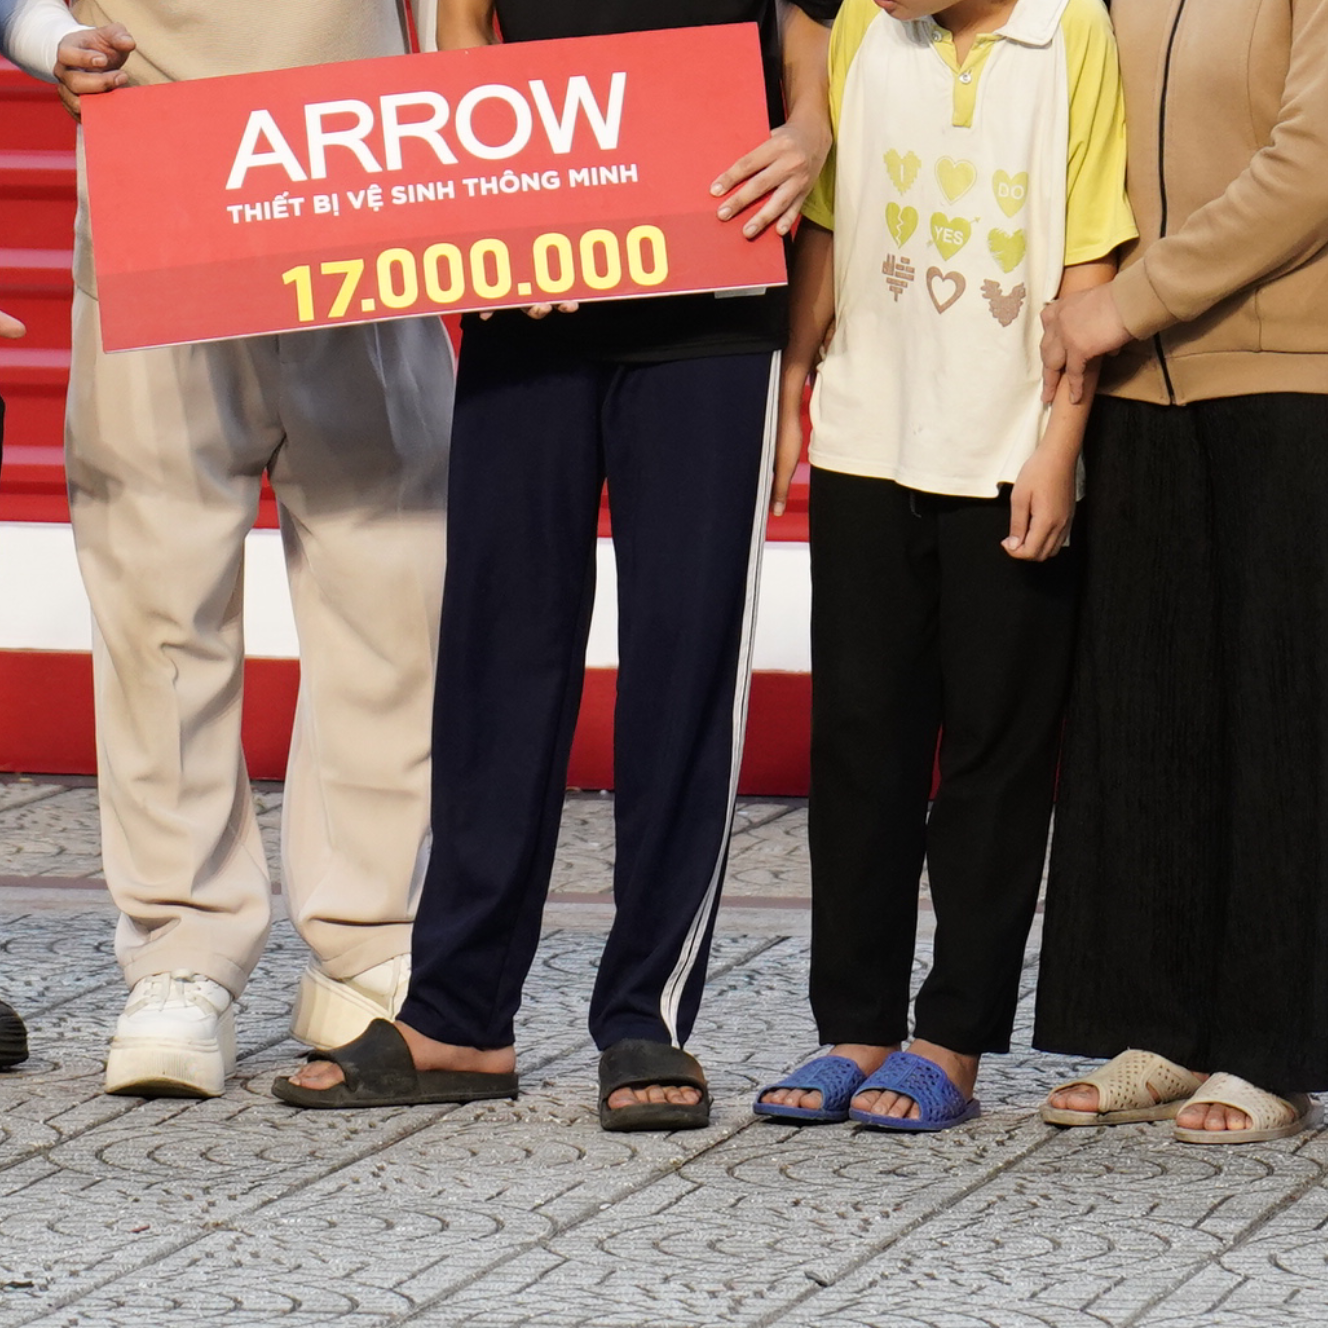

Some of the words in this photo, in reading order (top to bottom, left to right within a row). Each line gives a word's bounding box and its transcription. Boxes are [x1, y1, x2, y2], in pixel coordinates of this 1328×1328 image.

[225, 72, 627, 191] ARROW
[226, 190, 306, 225] THIẾT
[313, 194, 340, 217] BỊ
[346, 187, 385, 213] VỆ
[390, 180, 456, 205] SINH
[462, 169, 561, 197] THÔNG
[568, 163, 639, 188] MINH
[997, 182, 1025, 200] DO
[934, 224, 964, 246] YES
[281, 224, 670, 323] 17.000.000
